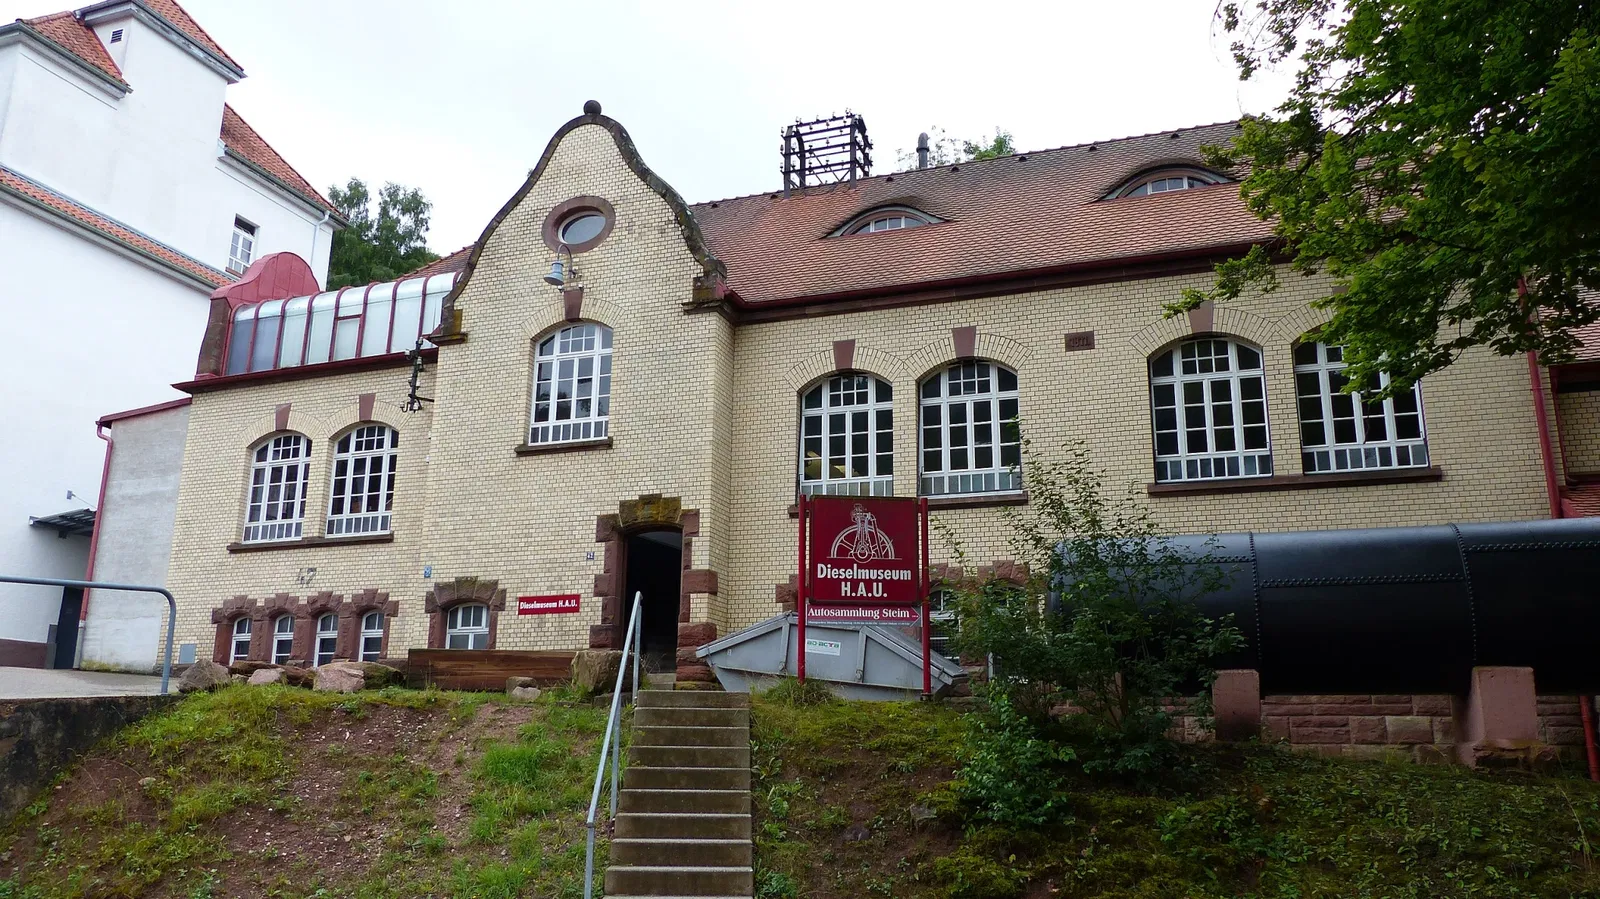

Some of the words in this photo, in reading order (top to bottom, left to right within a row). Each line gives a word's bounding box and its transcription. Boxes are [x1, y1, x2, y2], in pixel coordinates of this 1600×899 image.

[817, 563, 912, 581] Dieselmuseum
[841, 581, 888, 597] H.A.U.
[519, 601, 558, 610] Dieselmuseum
[558, 600, 578, 608] H.A.U.
[807, 607, 880, 620] Autosammlung
[882, 608, 910, 618] Steim
